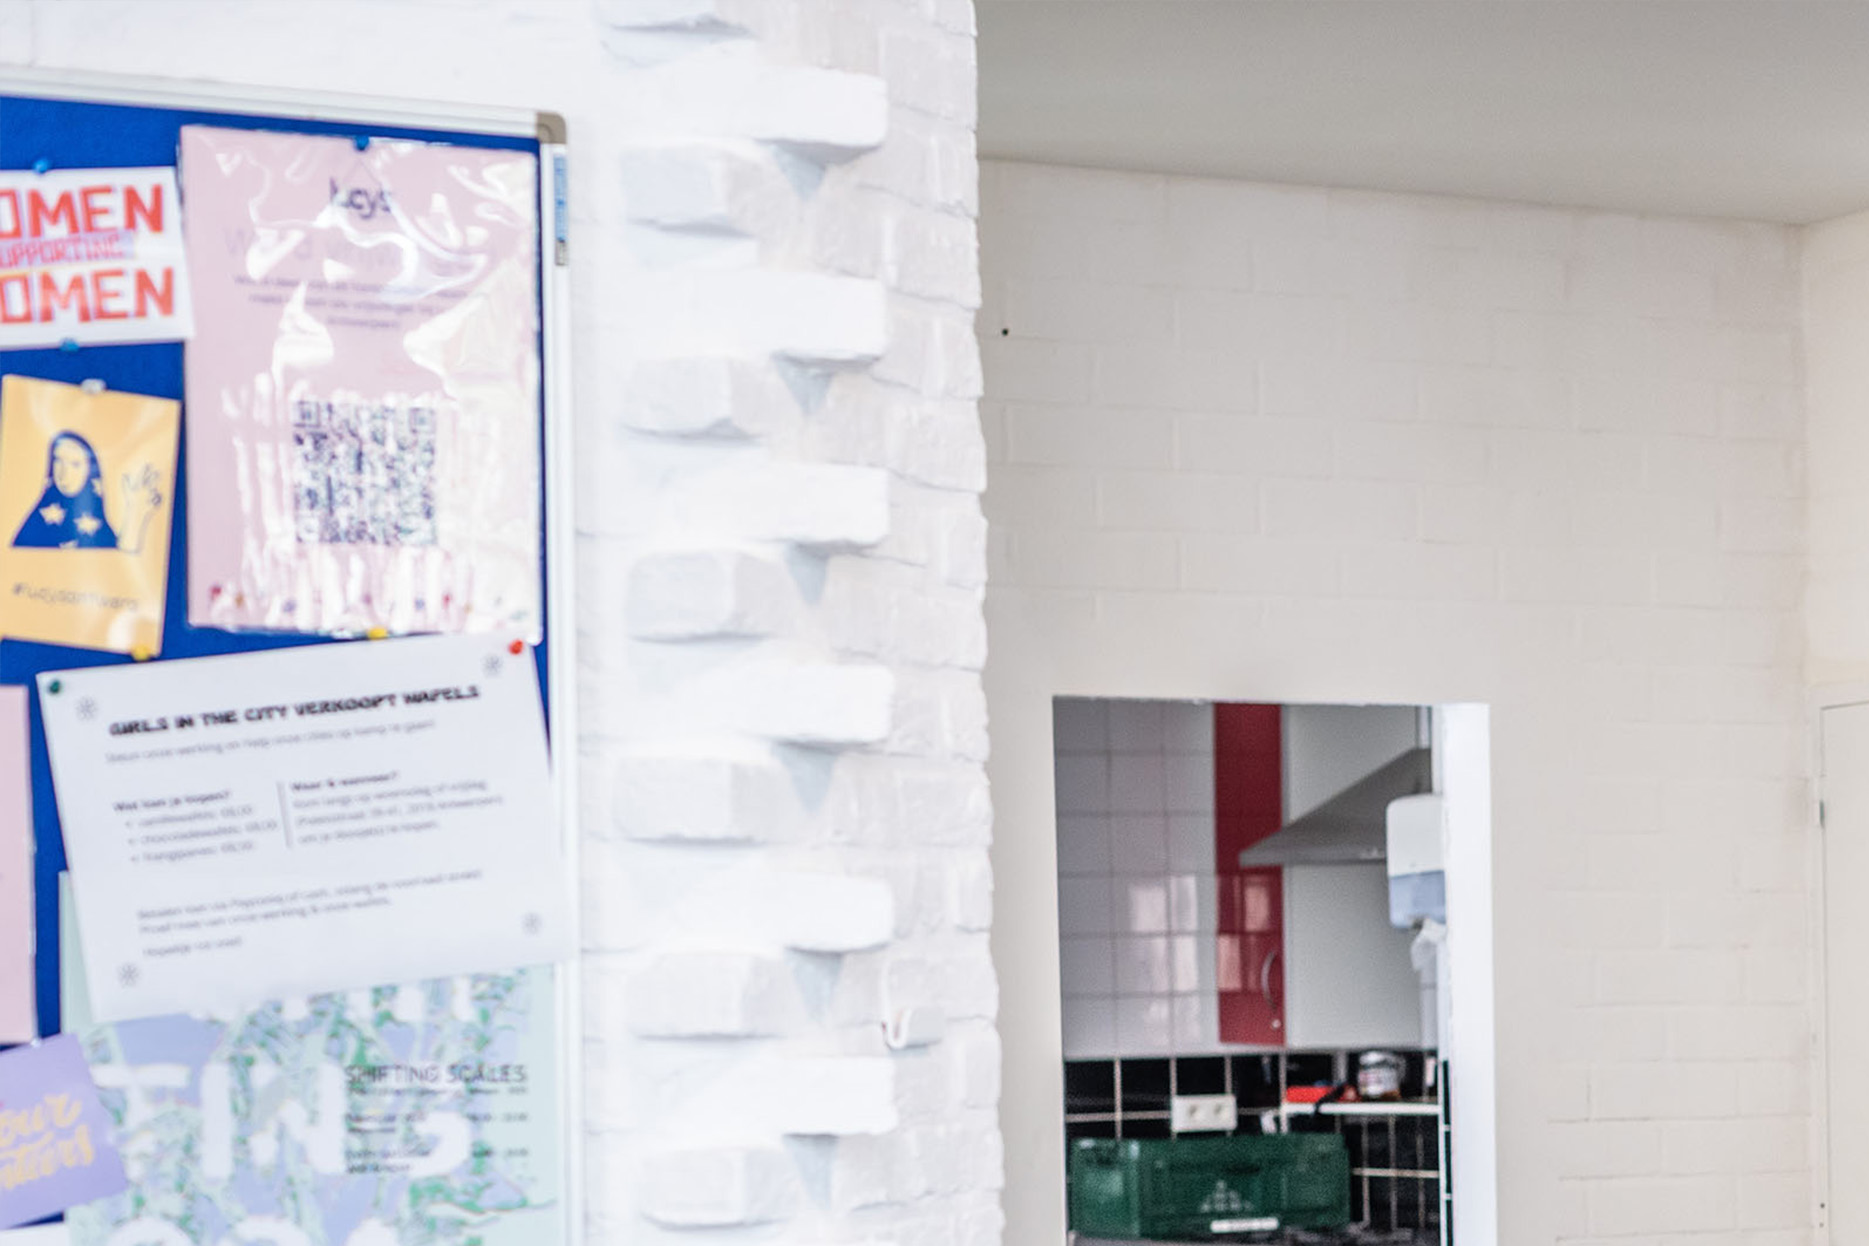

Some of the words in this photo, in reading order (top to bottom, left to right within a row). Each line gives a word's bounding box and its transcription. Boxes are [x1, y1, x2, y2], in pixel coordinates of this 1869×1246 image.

[109, 717, 168, 737] GIRLS
[175, 715, 194, 730] IN
[202, 709, 238, 726] THE
[244, 705, 287, 722] CITY
[294, 693, 397, 717] VERKOOPT
[402, 685, 481, 705] WAFELS
[446, 1063, 528, 1083] SCALES
